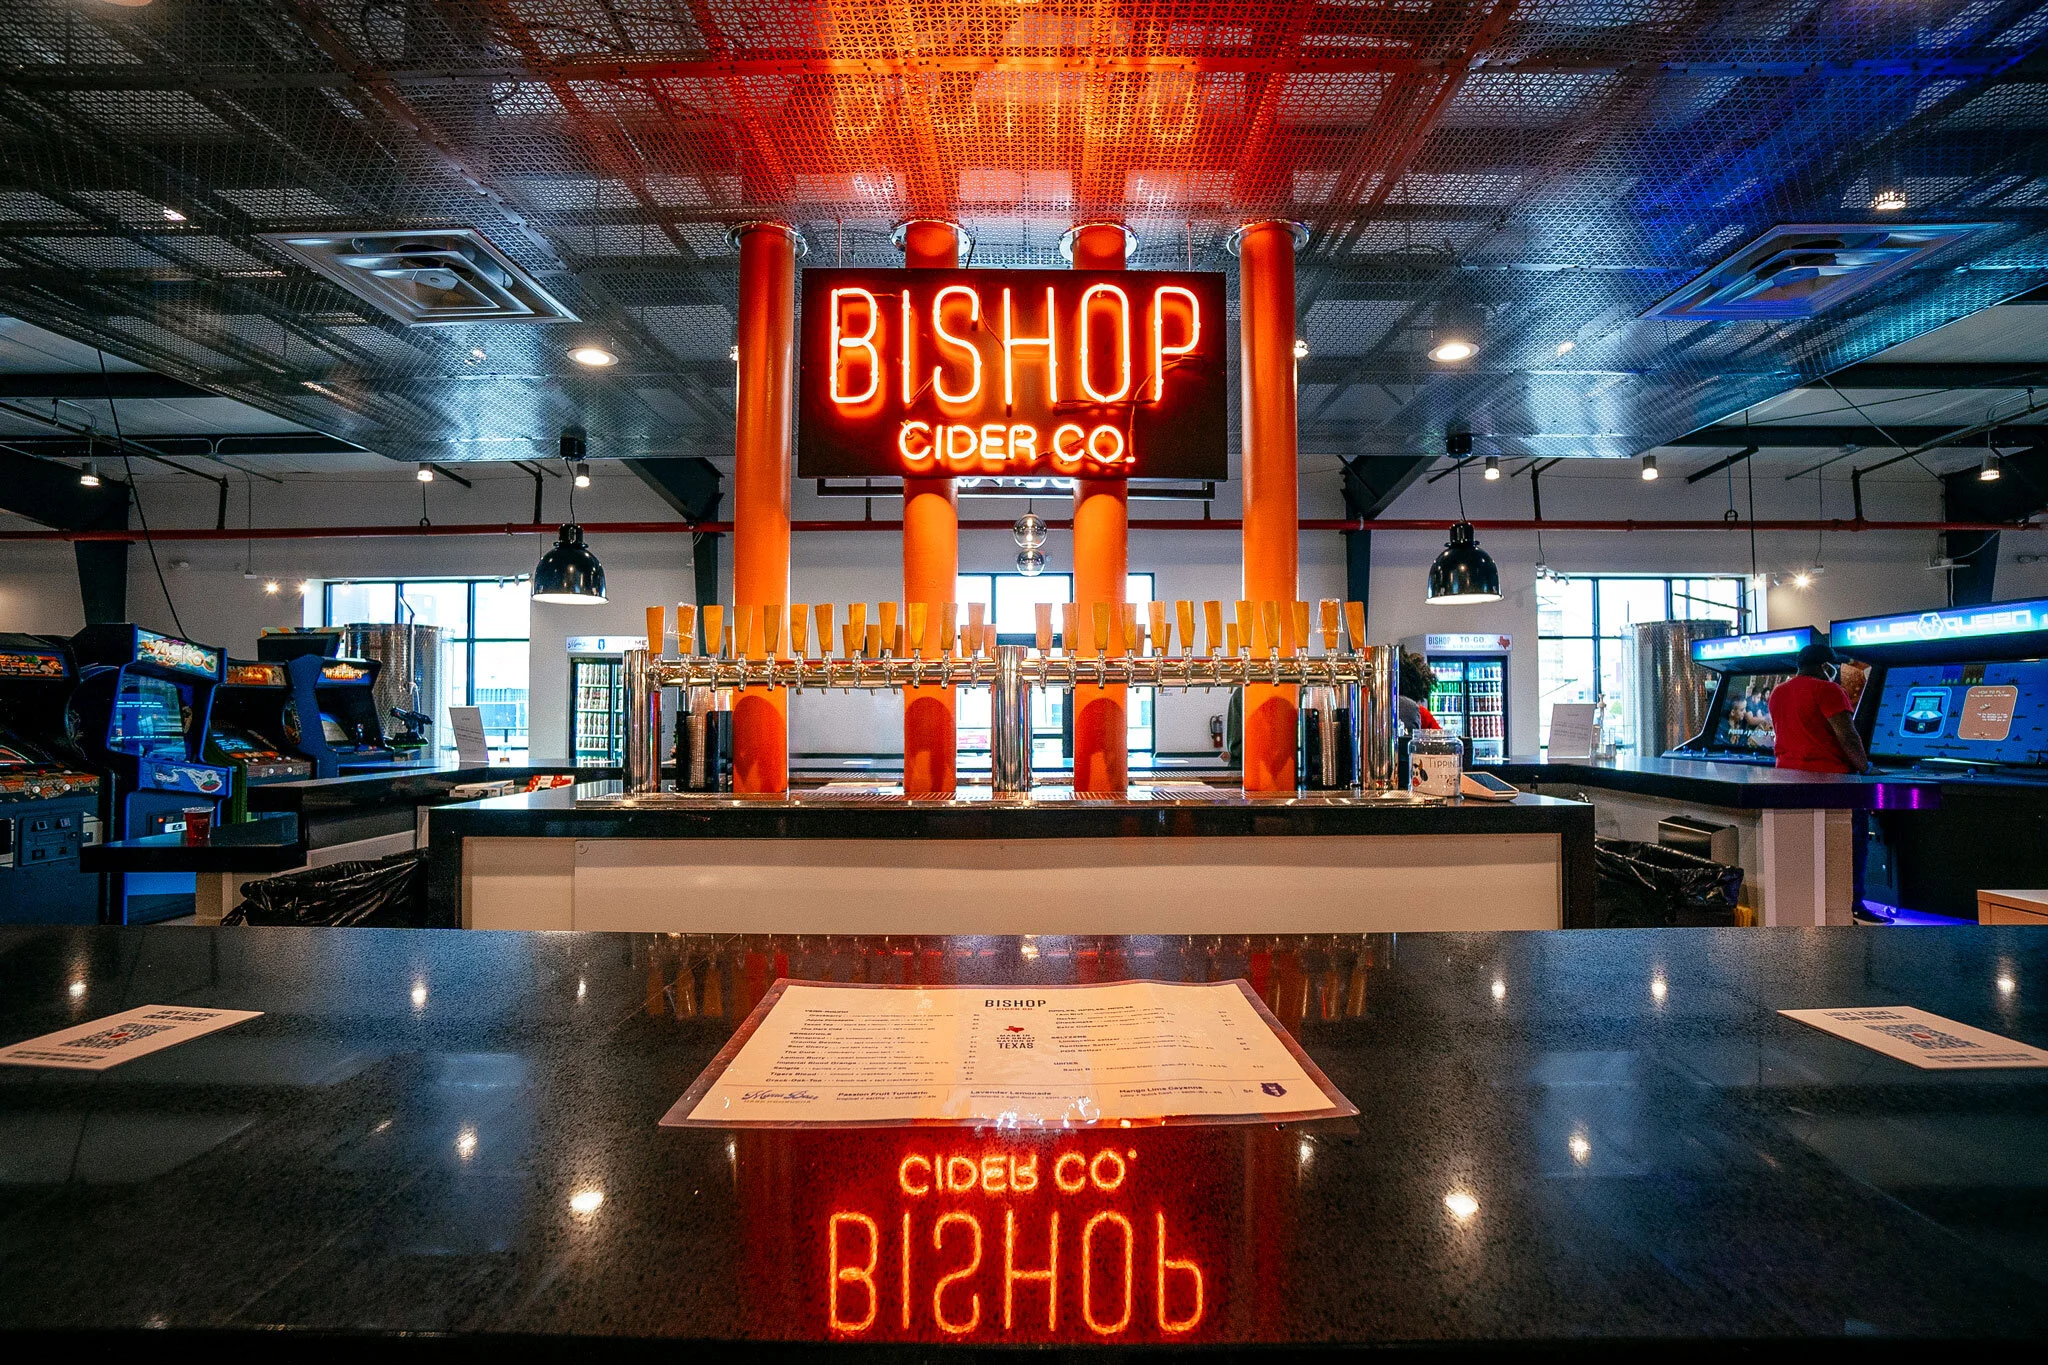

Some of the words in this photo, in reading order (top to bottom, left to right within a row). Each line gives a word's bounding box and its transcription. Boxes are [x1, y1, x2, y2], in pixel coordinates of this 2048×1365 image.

[830, 284, 1200, 405] BISHOP
[900, 420, 1038, 462] CIDER
[1054, 423, 1135, 463] CO.
[1428, 636, 1450, 645] BISHOP
[985, 999, 1047, 1008] BISHOP
